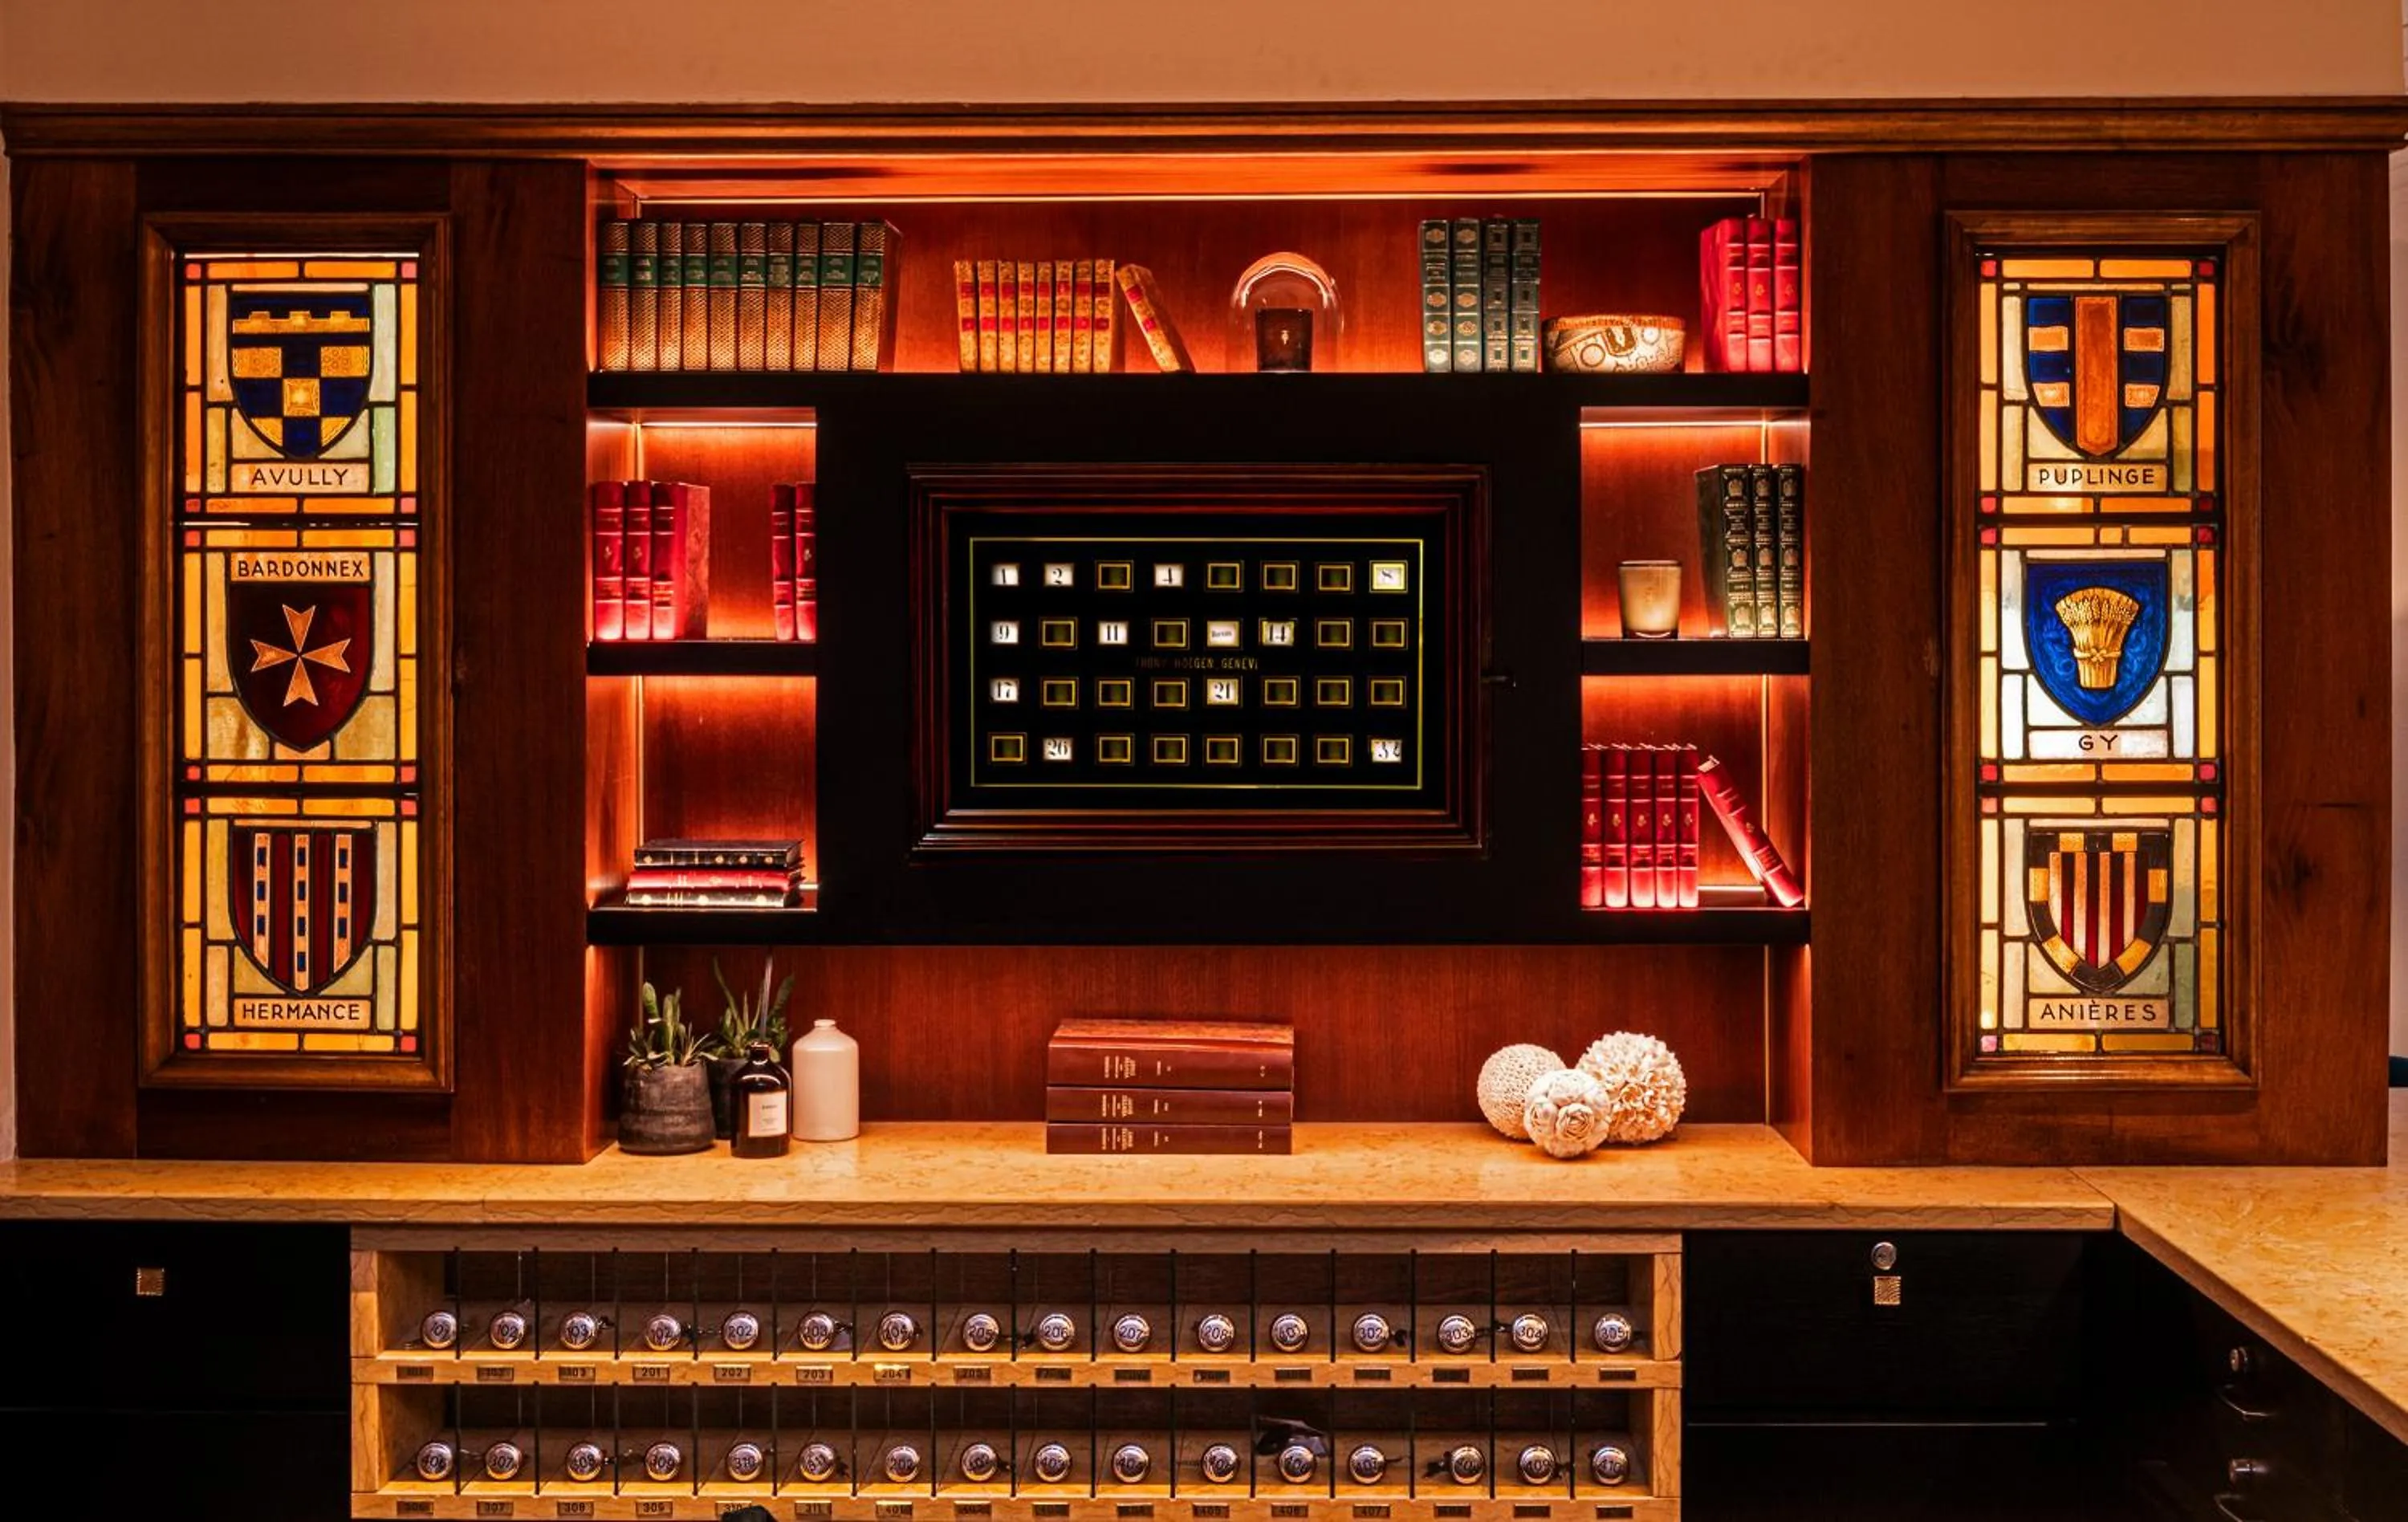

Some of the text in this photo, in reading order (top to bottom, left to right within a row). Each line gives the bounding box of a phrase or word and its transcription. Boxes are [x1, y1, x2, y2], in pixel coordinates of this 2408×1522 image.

[250, 468, 349, 486] AVULLY
[2039, 468, 2154, 484] PUPLINGE
[238, 560, 364, 577] BARDONNEX
[1052, 568, 1063, 584] 2
[1162, 568, 1174, 584] 4
[999, 625, 1010, 640] 9
[1107, 625, 1119, 641] 11
[1268, 624, 1287, 642] 14
[997, 683, 1011, 698] 17
[1214, 682, 1230, 699] 21
[1047, 739, 1068, 757] 26
[2078, 735, 2118, 751] GY
[242, 1003, 360, 1020] HERMANCE
[2040, 999, 2157, 1021] ANIÈRES
[728, 1325, 752, 1339] 202
[968, 1325, 995, 1342] 205
[1044, 1325, 1068, 1338] 206
[1119, 1325, 1142, 1340] 207
[1205, 1325, 1229, 1340] 208
[1359, 1327, 1382, 1341] 302
[1519, 1325, 1542, 1339] 304
[641, 1368, 661, 1377] 201
[722, 1368, 743, 1377] 202
[563, 1502, 586, 1513] 308
